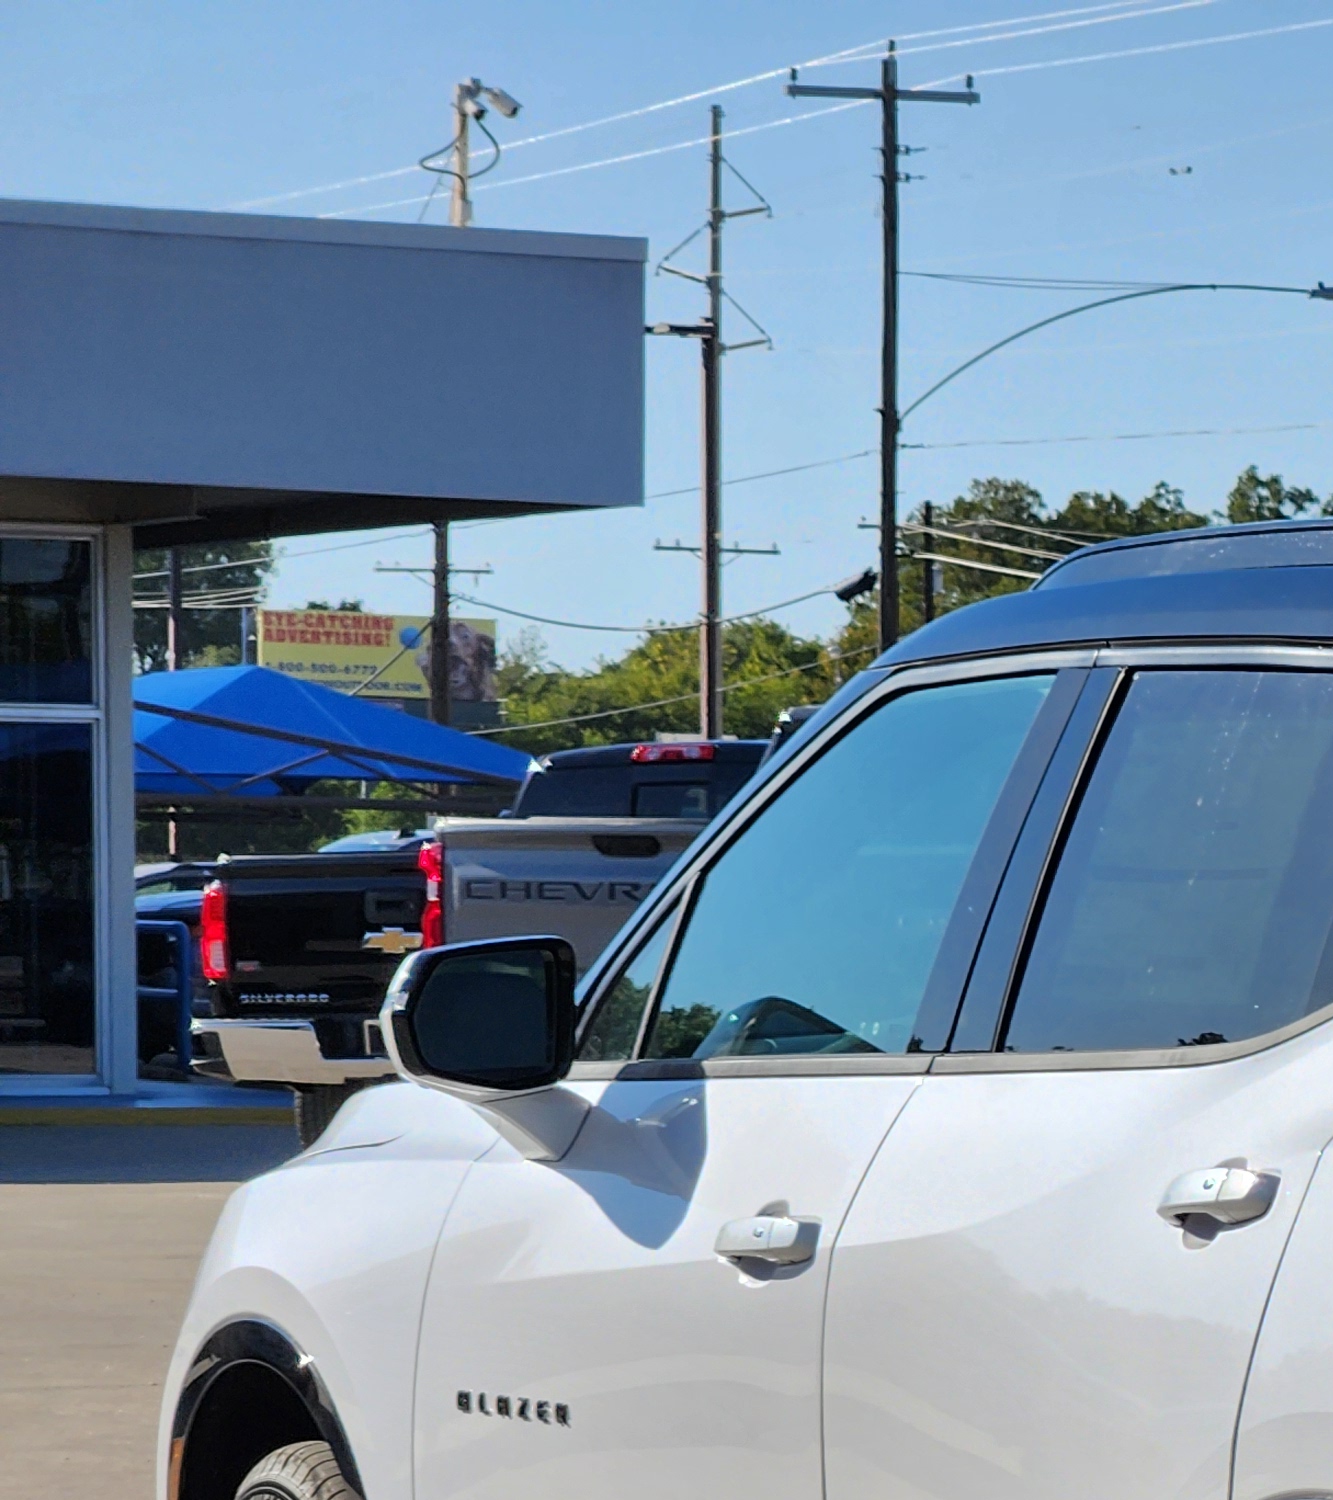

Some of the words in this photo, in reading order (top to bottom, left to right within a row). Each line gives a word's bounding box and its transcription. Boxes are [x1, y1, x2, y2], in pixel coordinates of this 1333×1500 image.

[263, 611, 394, 630] EYE-CATCHING
[264, 627, 391, 646] ADVERTISING!
[465, 880, 654, 900] CHEVR
[240, 992, 330, 1004] SILVERADO
[457, 1389, 572, 1429] BLAZER
